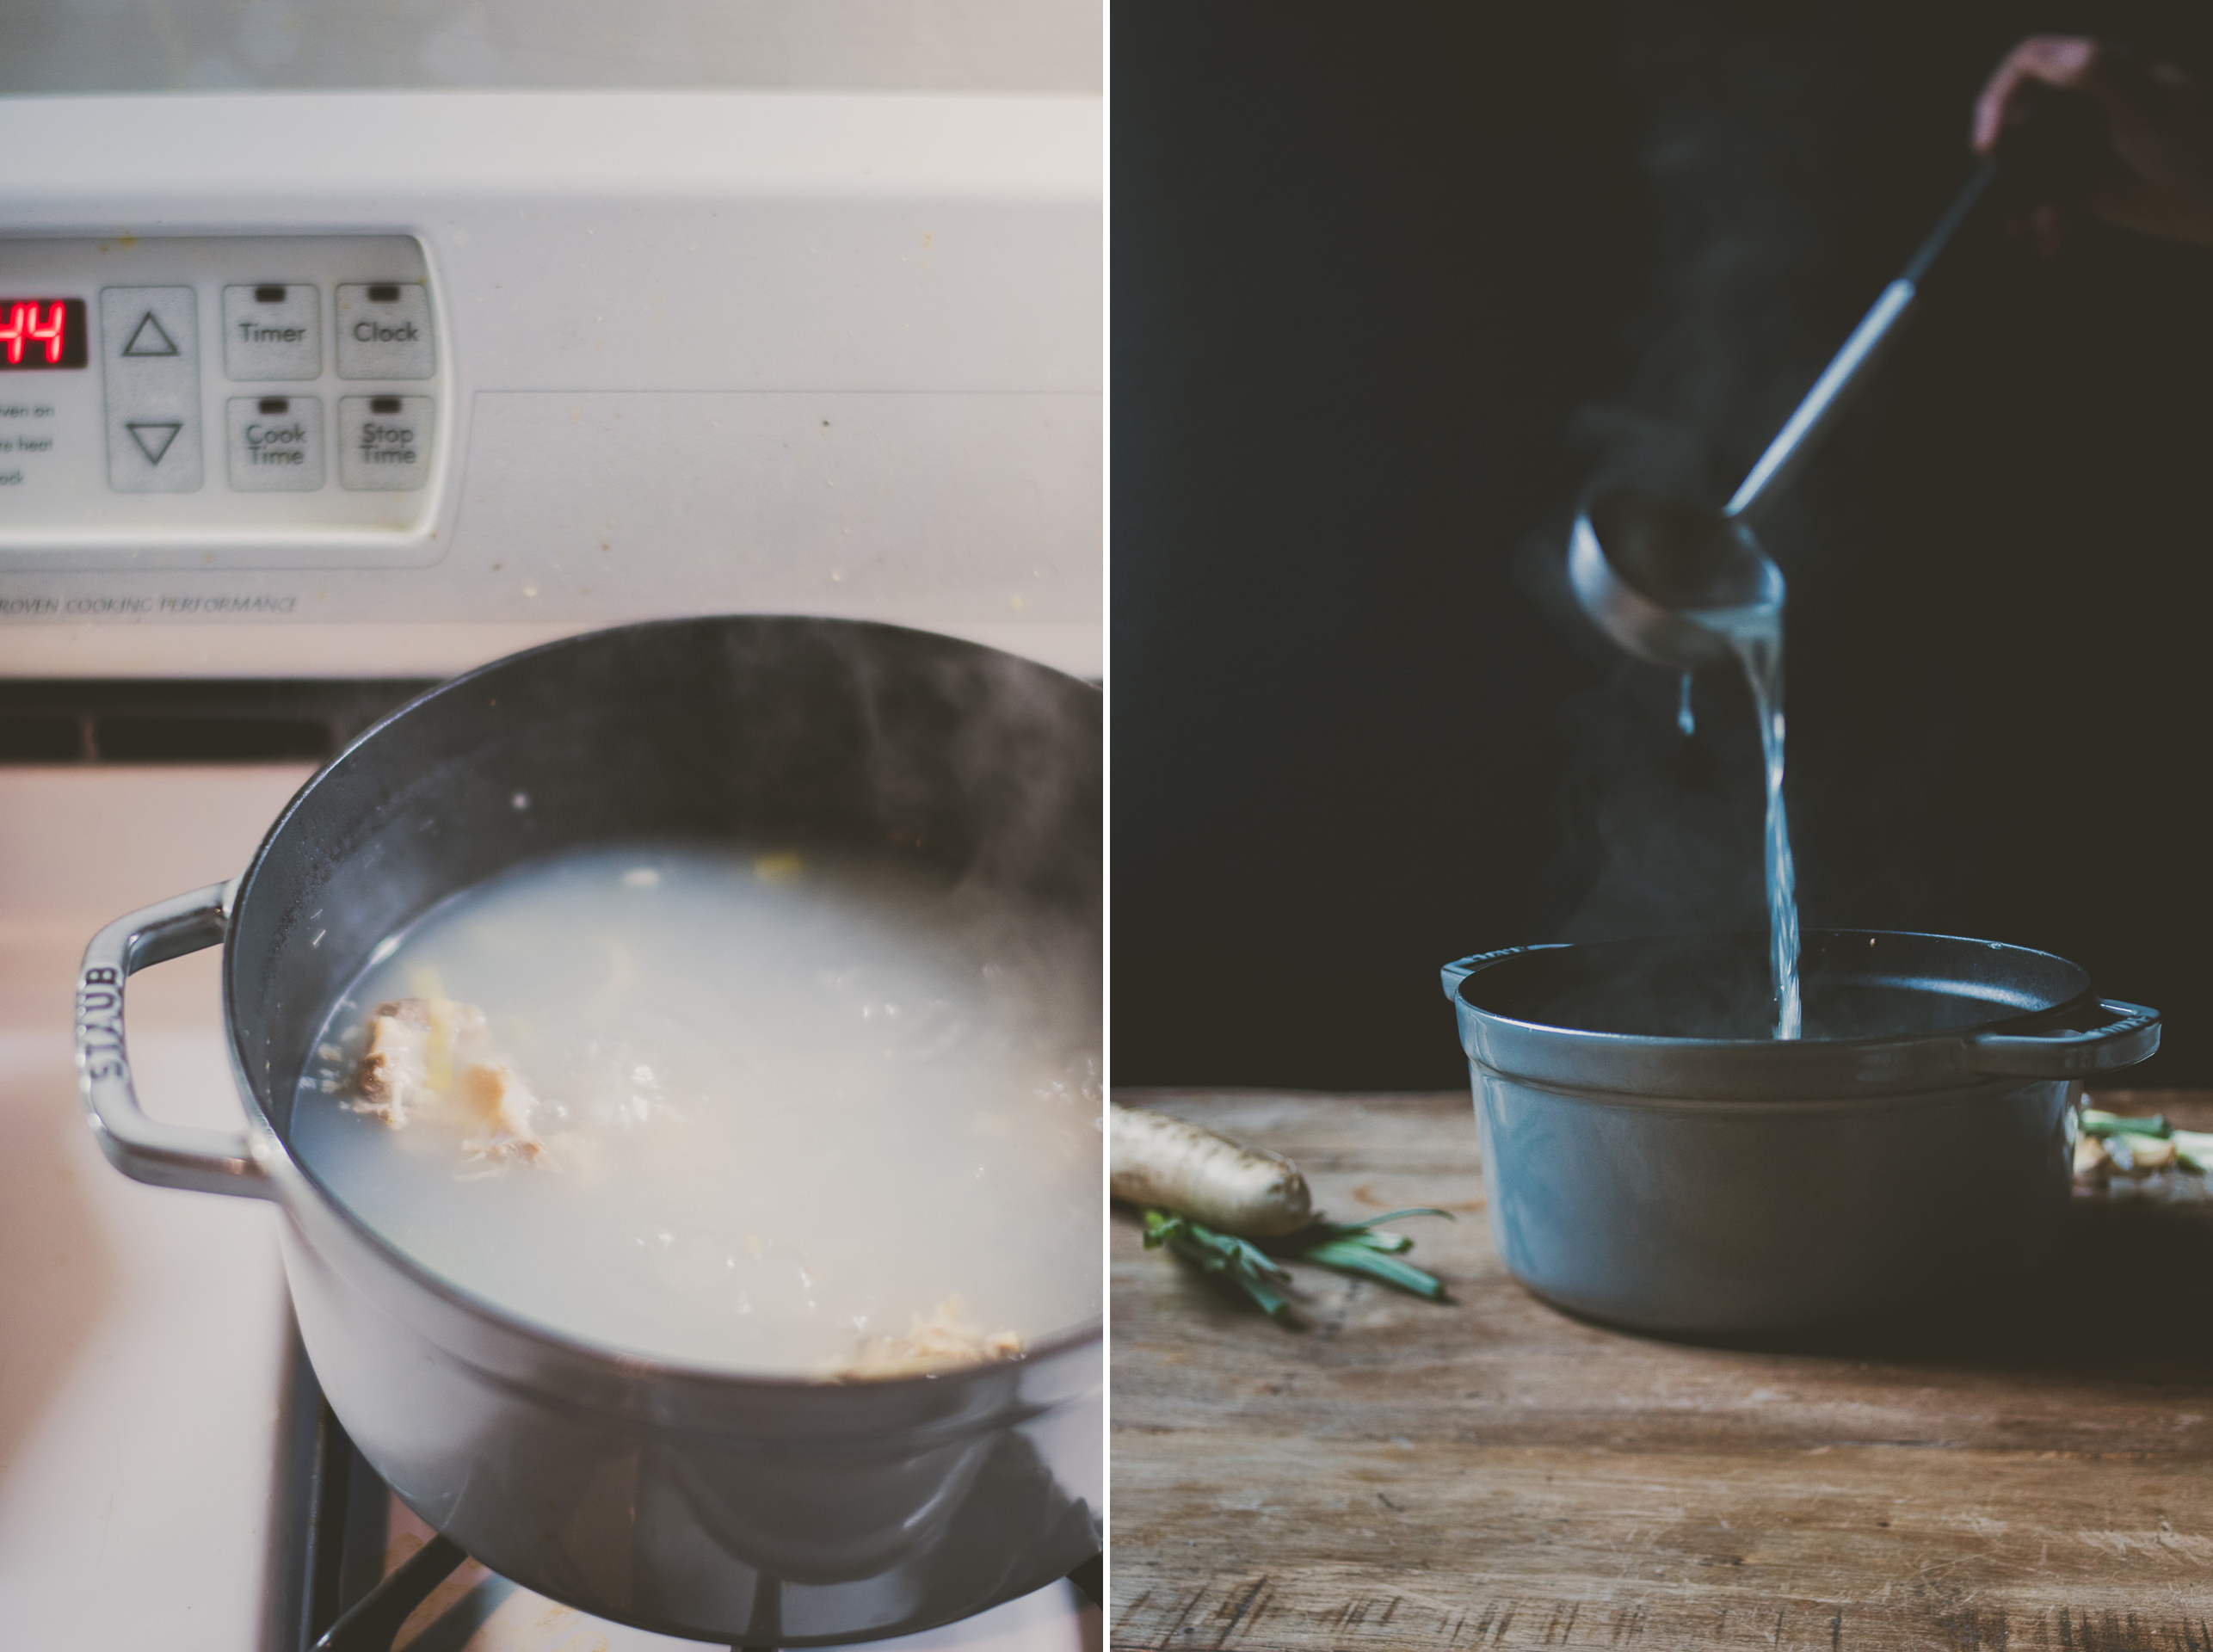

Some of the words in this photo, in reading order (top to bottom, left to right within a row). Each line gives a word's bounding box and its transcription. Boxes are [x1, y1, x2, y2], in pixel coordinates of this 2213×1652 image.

[238, 322, 306, 343] Timer
[353, 321, 419, 342] Clock
[0, 405, 29, 419] ven
[245, 423, 306, 445] Cook
[361, 422, 414, 447] Stop
[248, 446, 305, 465] Time
[359, 444, 417, 465] Time
[65, 597, 152, 614] COOKING
[159, 596, 298, 613] PERFORMANCE
[84, 966, 123, 1080] STAUB
